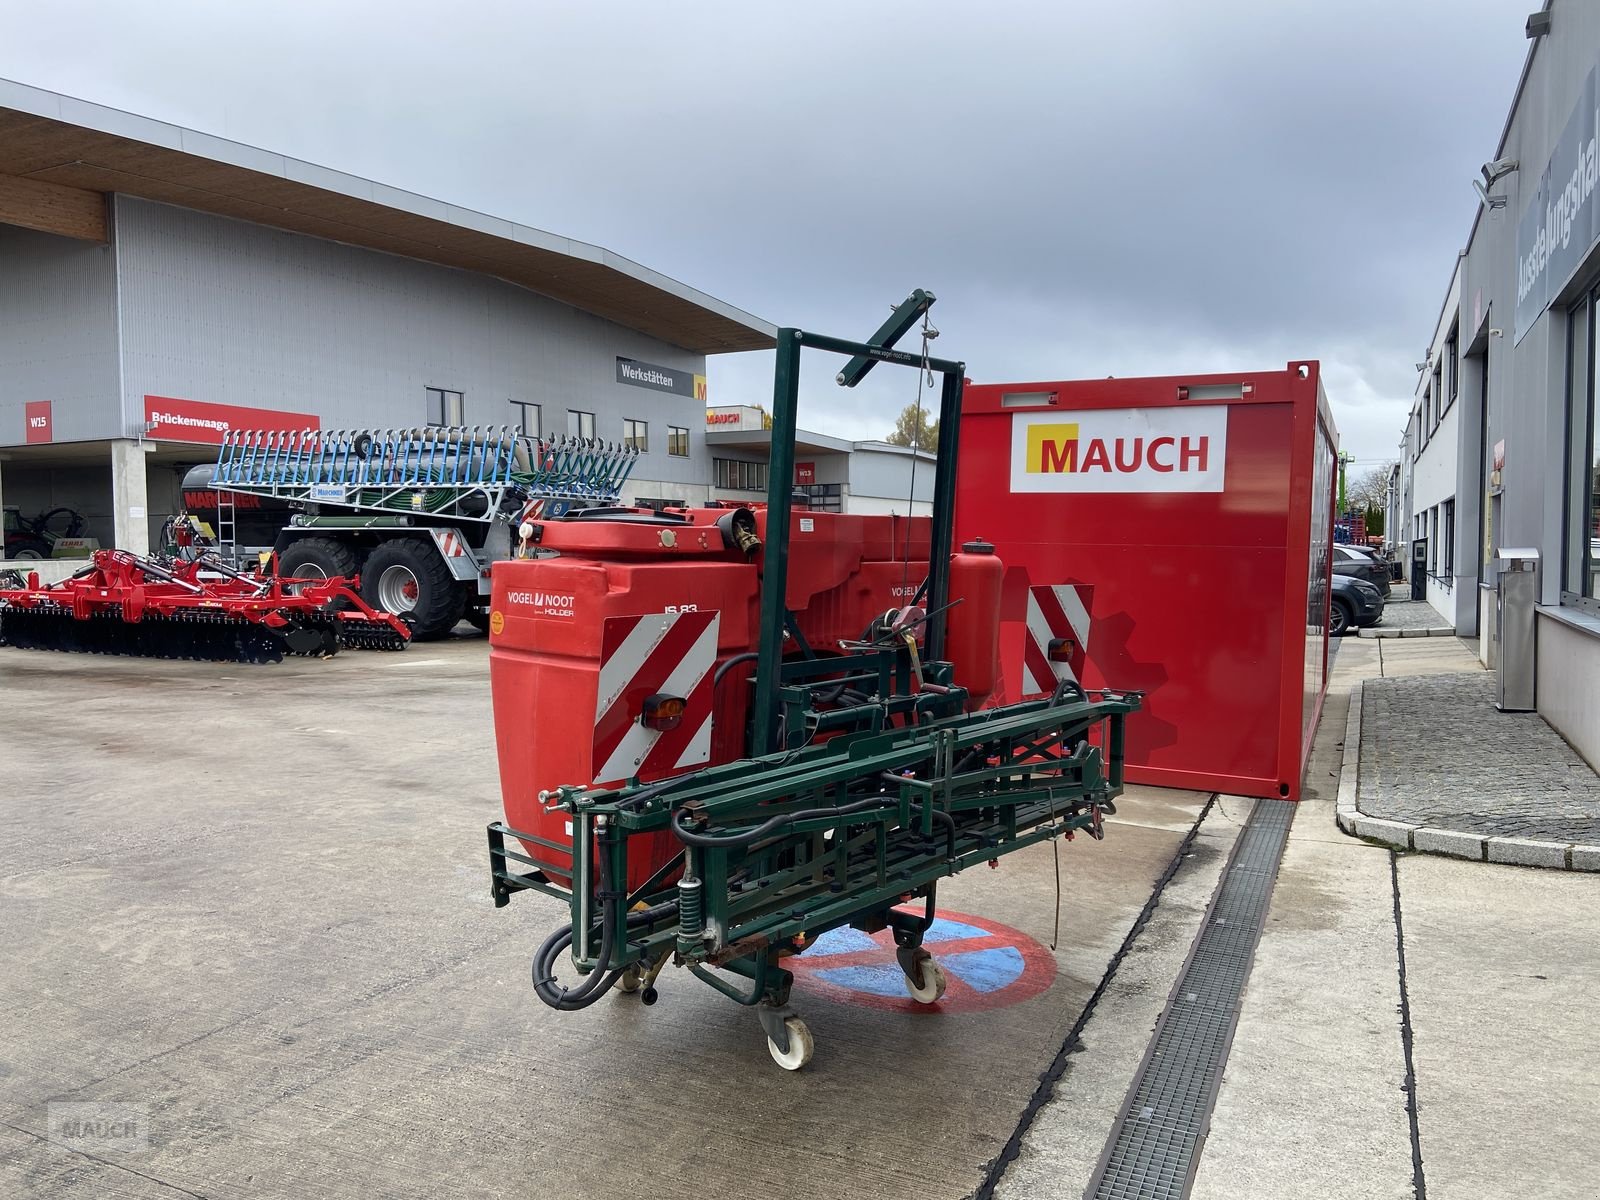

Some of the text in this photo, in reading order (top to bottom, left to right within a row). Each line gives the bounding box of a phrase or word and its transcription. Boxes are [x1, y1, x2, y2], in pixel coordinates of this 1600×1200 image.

[621, 363, 673, 387] Werkstätten
[30, 416, 47, 428] W15
[151, 411, 229, 431] Brückenwaage
[706, 413, 740, 424] MAUCH
[1040, 436, 1209, 473] MAUCH
[891, 586, 915, 597] VOGEL
[508, 591, 574, 608] VOGEL NOOT
[544, 608, 574, 617] HOLDER
